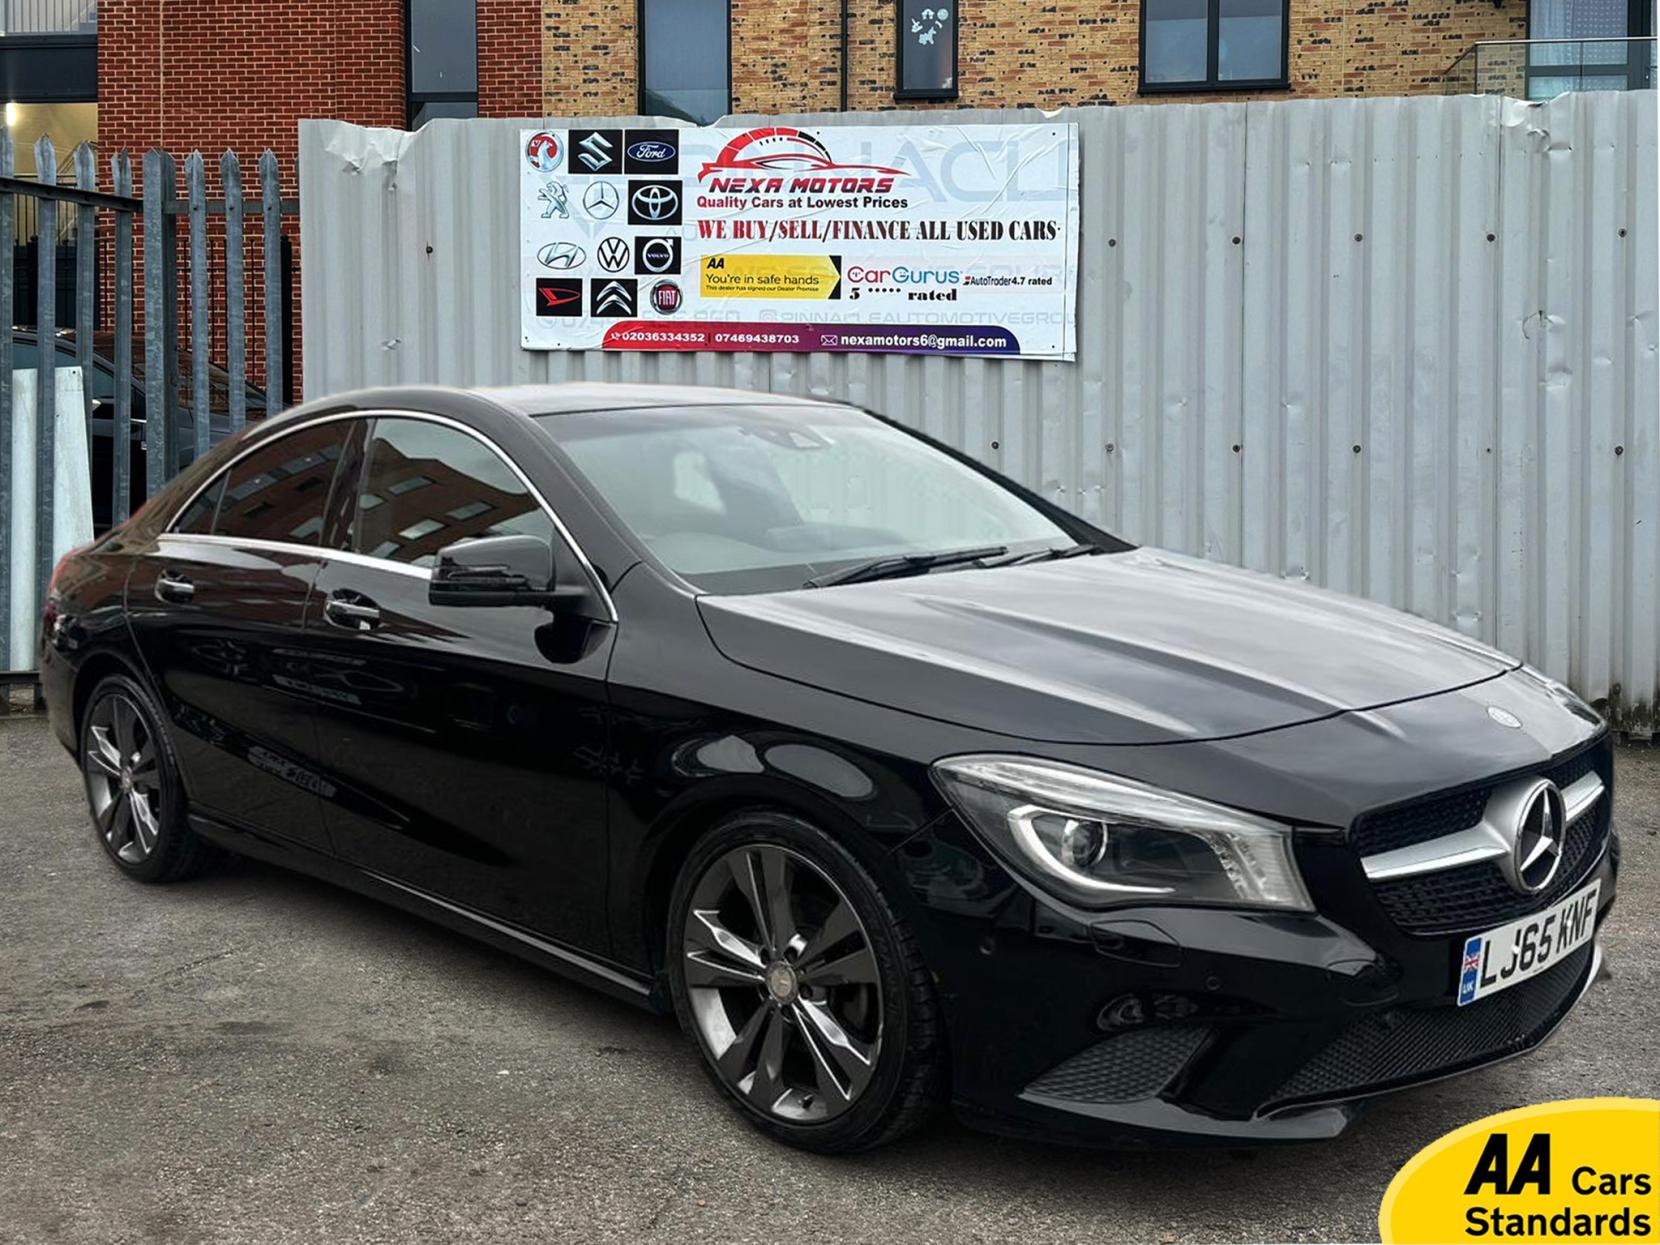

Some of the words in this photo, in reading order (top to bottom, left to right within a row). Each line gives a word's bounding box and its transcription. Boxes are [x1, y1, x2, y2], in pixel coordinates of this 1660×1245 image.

[636, 144, 666, 159] Ford
[709, 178, 784, 193] NEXA
[789, 178, 895, 193] MOTORS
[697, 196, 748, 210] Quality
[752, 196, 784, 208] Cars
[788, 196, 803, 208] at
[807, 197, 859, 208] Lowest
[863, 196, 908, 208] Prices
[697, 220, 726, 239] WE
[733, 219, 911, 242] BUY/SELL/FINANCE
[916, 220, 951, 240] ALL
[957, 220, 1004, 240] USED
[1009, 220, 1057, 240] CARS
[707, 257, 725, 269] AA
[706, 274, 741, 284] You're
[744, 274, 754, 284] in
[757, 274, 781, 284] safe
[784, 274, 820, 285] hands
[847, 266, 960, 284] CarGurus
[1028, 276, 1053, 285] rated
[658, 290, 676, 305] FIAT
[849, 287, 860, 300] 5
[908, 288, 957, 300] rated
[622, 332, 705, 342] 02036334352
[715, 333, 799, 343] 07469438703
[841, 334, 1007, 349] nexamotors6@gmail.com
[1480, 913, 1556, 988] LJ65
[1556, 889, 1597, 954] KNF
